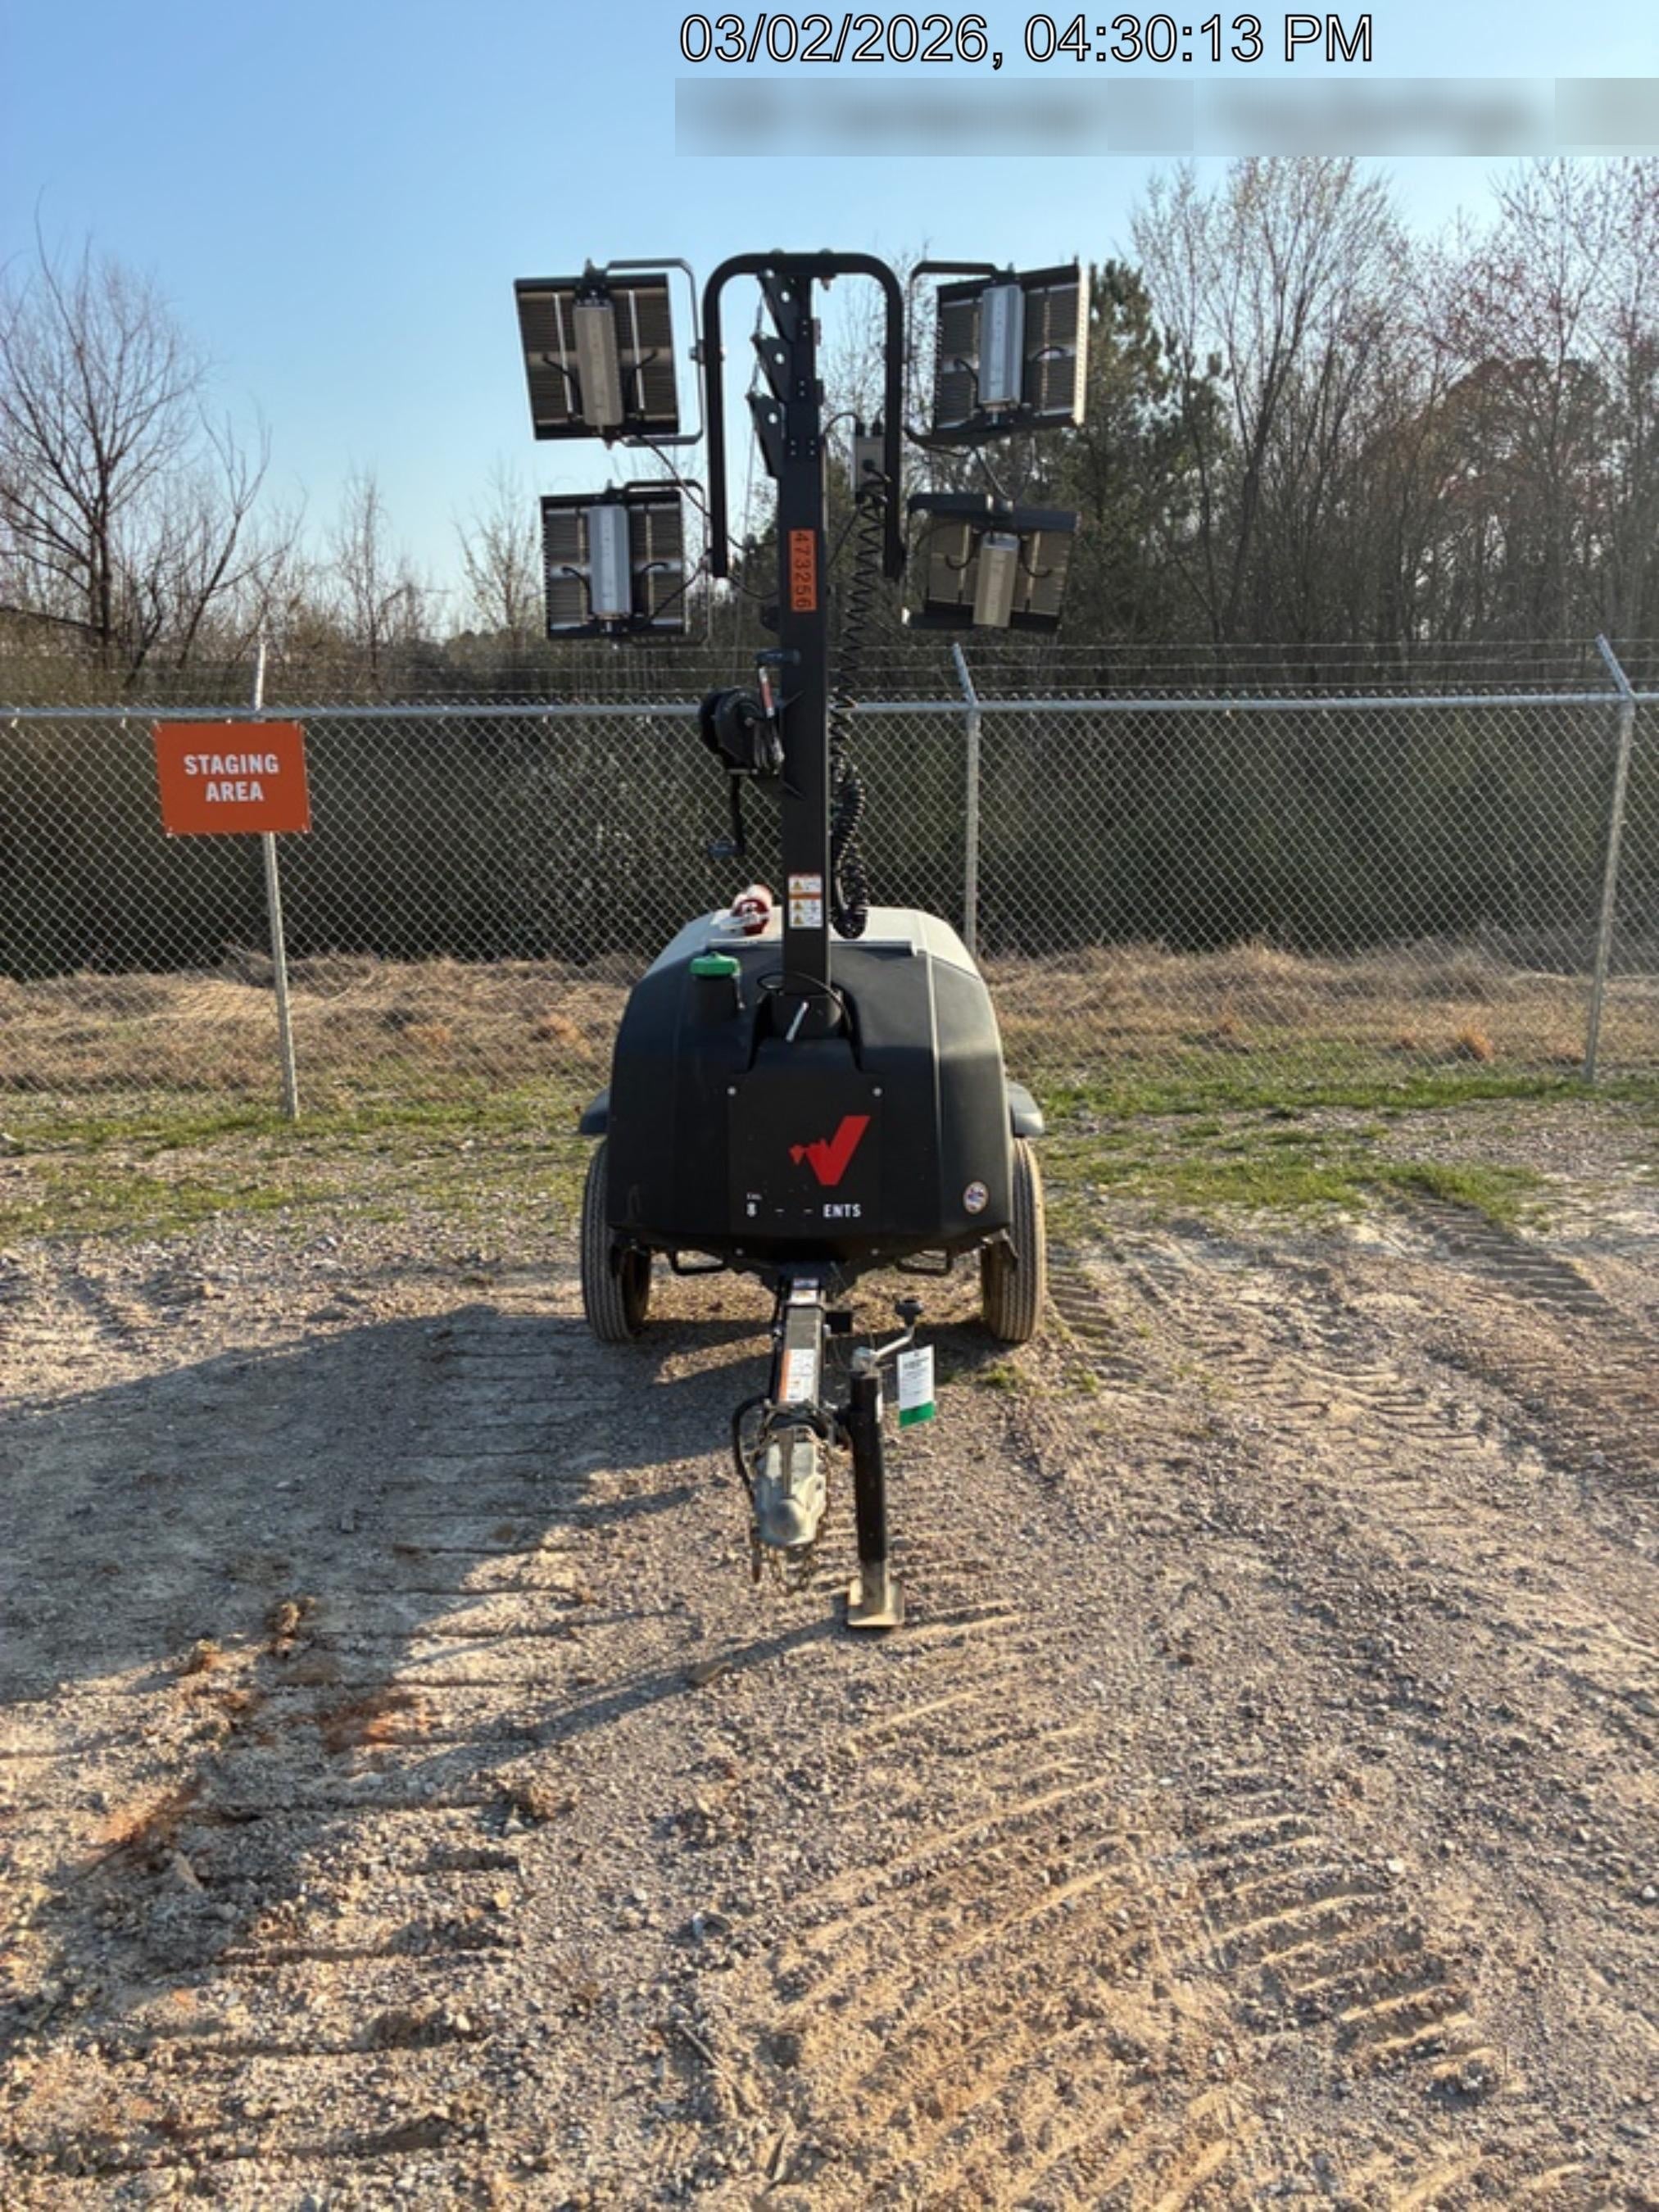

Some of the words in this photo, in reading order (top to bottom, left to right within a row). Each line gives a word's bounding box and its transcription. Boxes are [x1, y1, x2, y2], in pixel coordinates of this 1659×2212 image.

[793, 532, 813, 608] 473256
[183, 754, 279, 776] STAGING
[206, 781, 265, 802] AREA
[823, 1203, 861, 1218] ENTS
